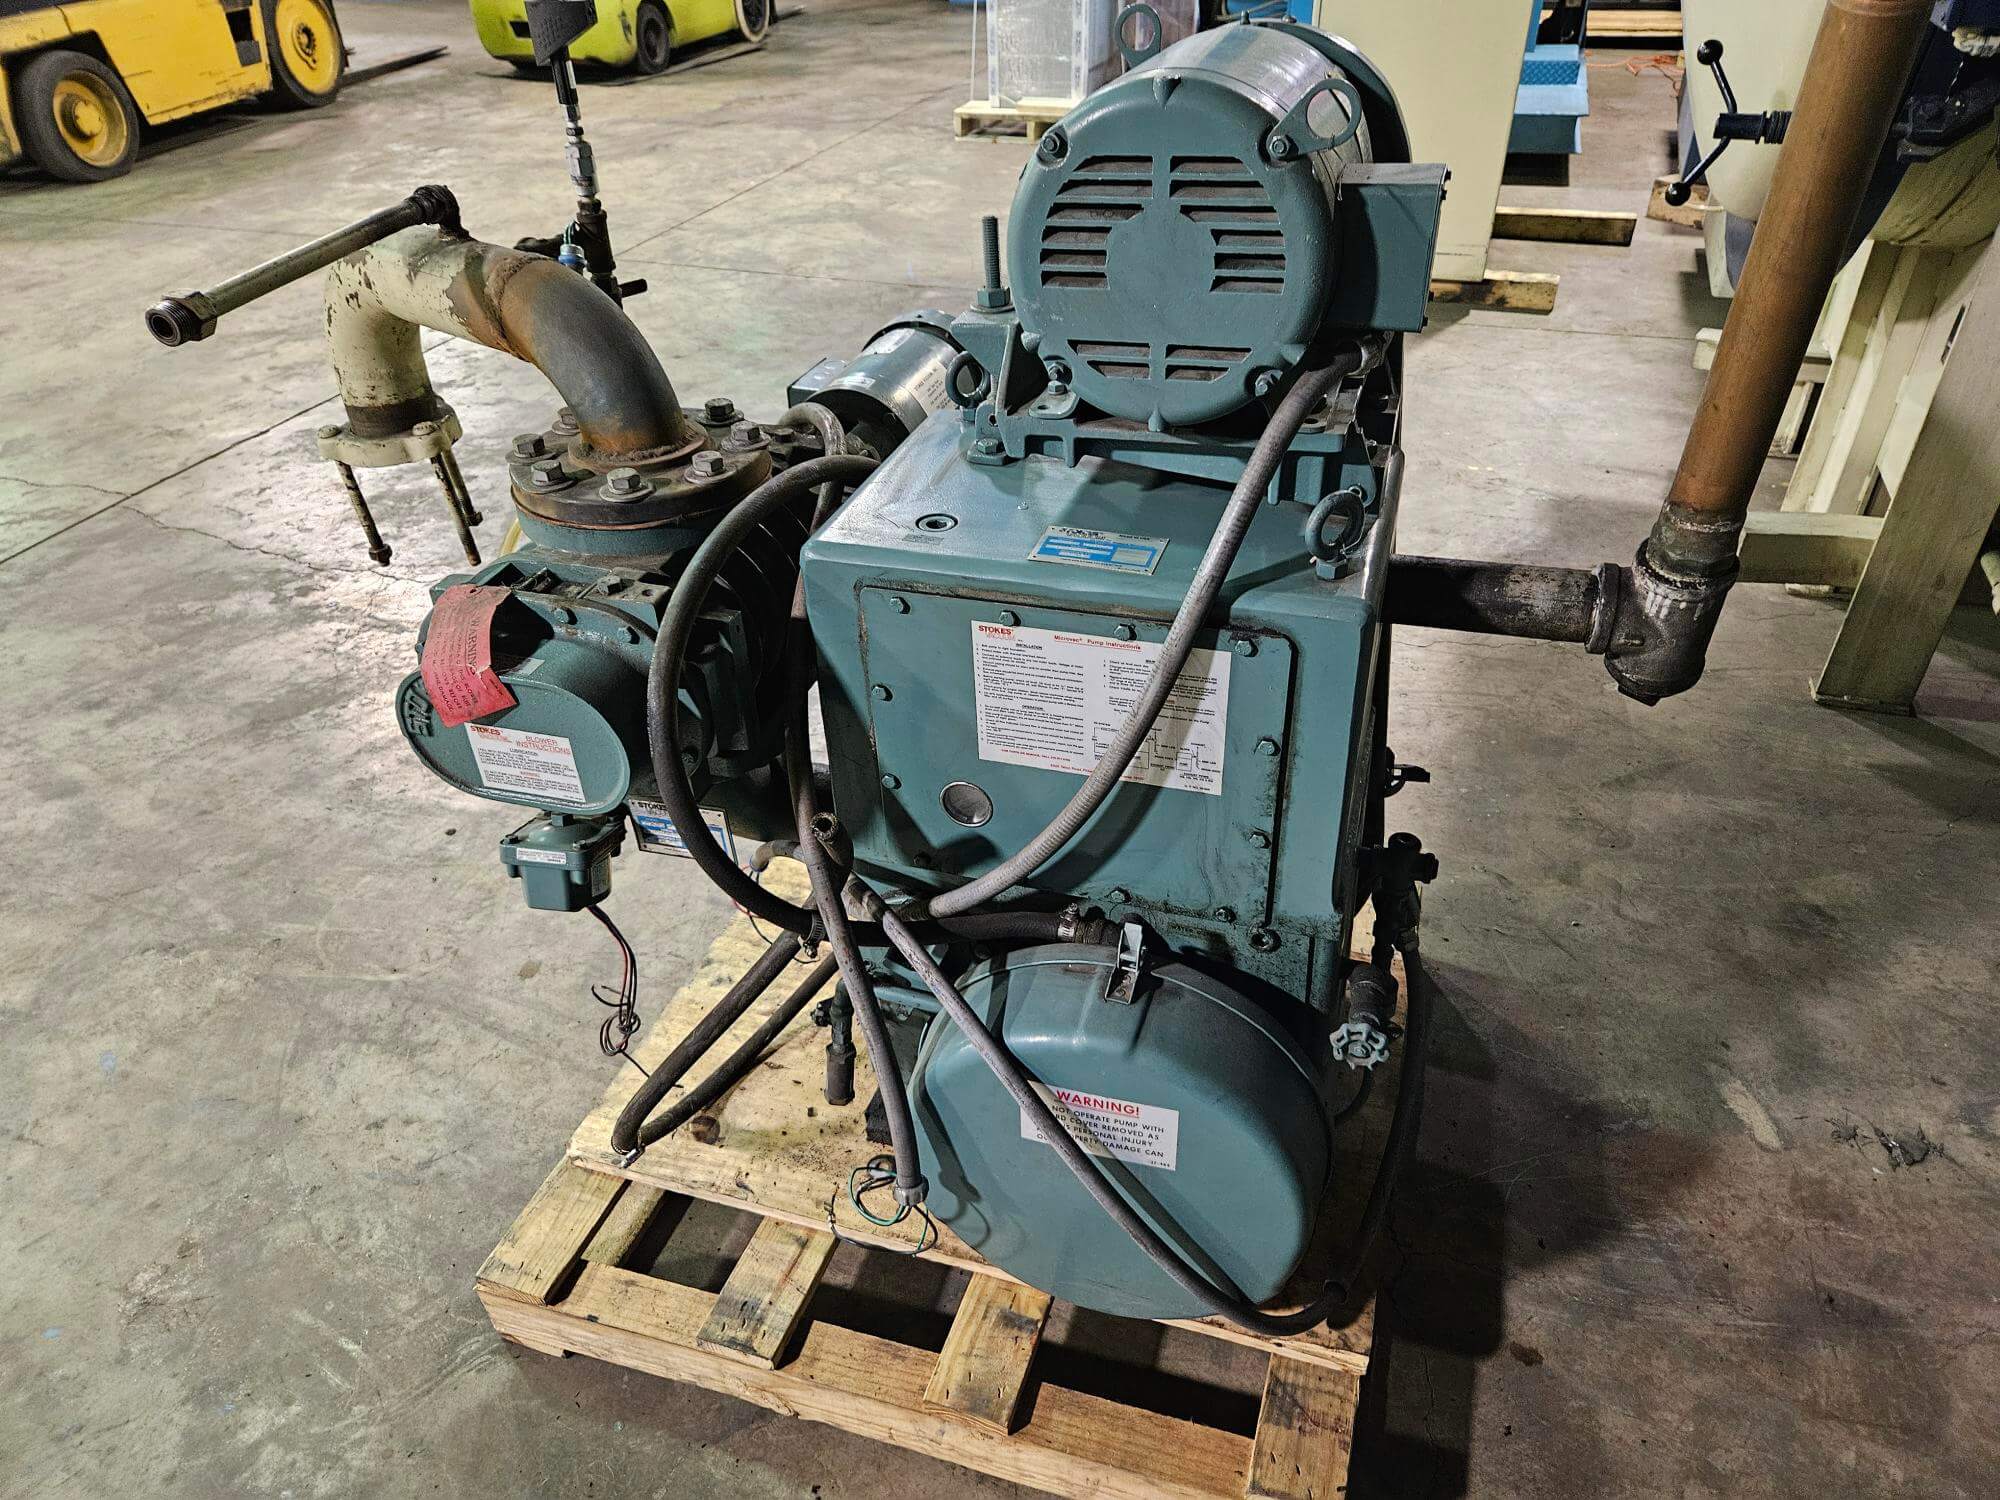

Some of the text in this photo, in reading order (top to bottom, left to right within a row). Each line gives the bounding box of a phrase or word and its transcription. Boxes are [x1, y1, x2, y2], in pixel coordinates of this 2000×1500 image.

[978, 625, 1012, 635] STOKES
[470, 725, 501, 735] STOKES
[515, 740, 571, 755] INSTRUCTIONS
[525, 735, 558, 745] BLOWER
[1056, 1090, 1139, 1115] WARNING!
[1051, 1105, 1074, 1116] NOT
[1074, 1110, 1111, 1123] OPERATE
[1114, 1118, 1138, 1129] PUMP
[1142, 1123, 1165, 1134] WITH
[1070, 1117, 1099, 1129] COVER
[1102, 1124, 1144, 1138] REMOVED
[1147, 1132, 1160, 1141] AS
[1073, 1125, 1117, 1141] PERSONAL
[1121, 1134, 1153, 1148] INJURY
[1103, 1141, 1142, 1154] DAMAGE
[1145, 1149, 1165, 1158] CAN
